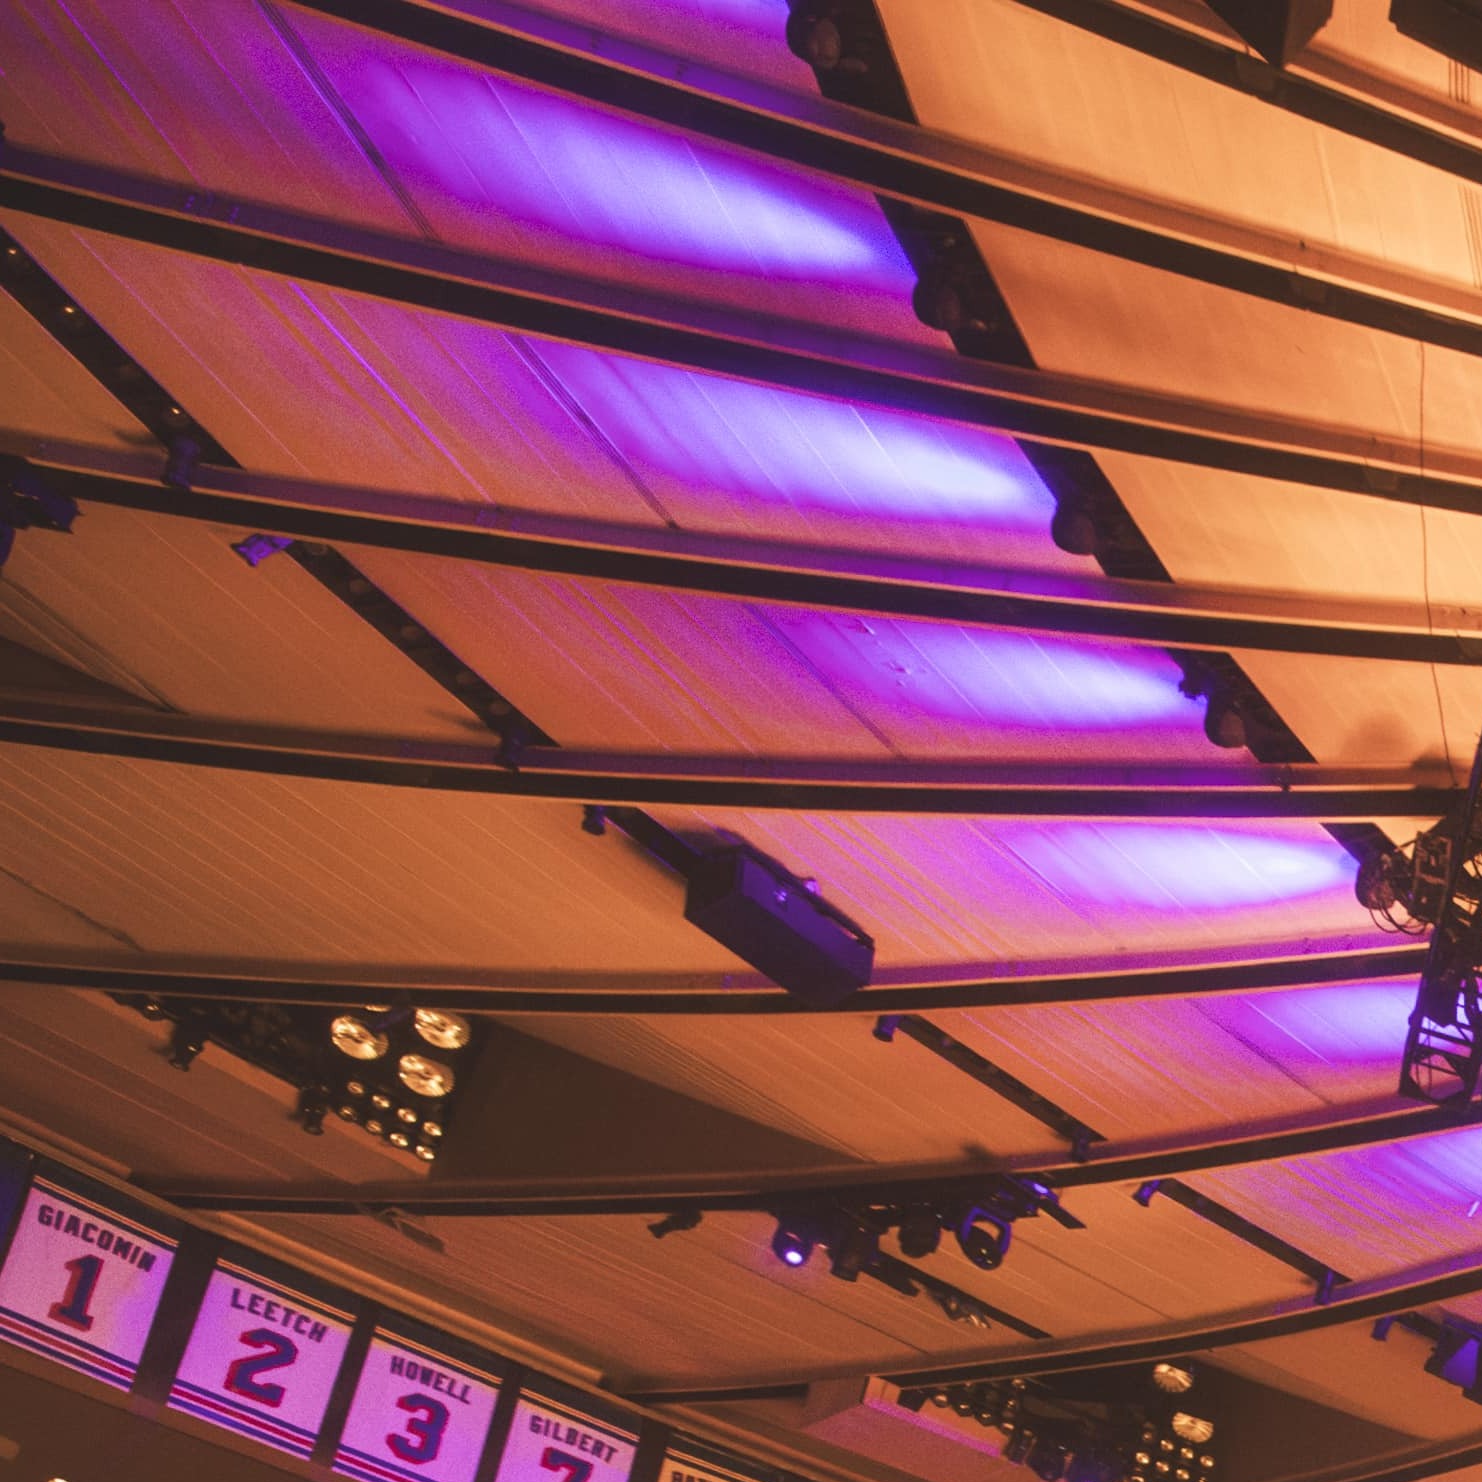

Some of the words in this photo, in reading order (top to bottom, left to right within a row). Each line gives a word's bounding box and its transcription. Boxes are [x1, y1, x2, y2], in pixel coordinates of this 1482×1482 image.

[37, 1204, 156, 1272] GIACOMIN
[48, 1255, 104, 1332] 1
[231, 1286, 328, 1343] LEETCH
[224, 1328, 300, 1408] 2
[389, 1353, 473, 1405] HOWELL
[386, 1394, 449, 1466] 3
[529, 1414, 620, 1464] GILBERT
